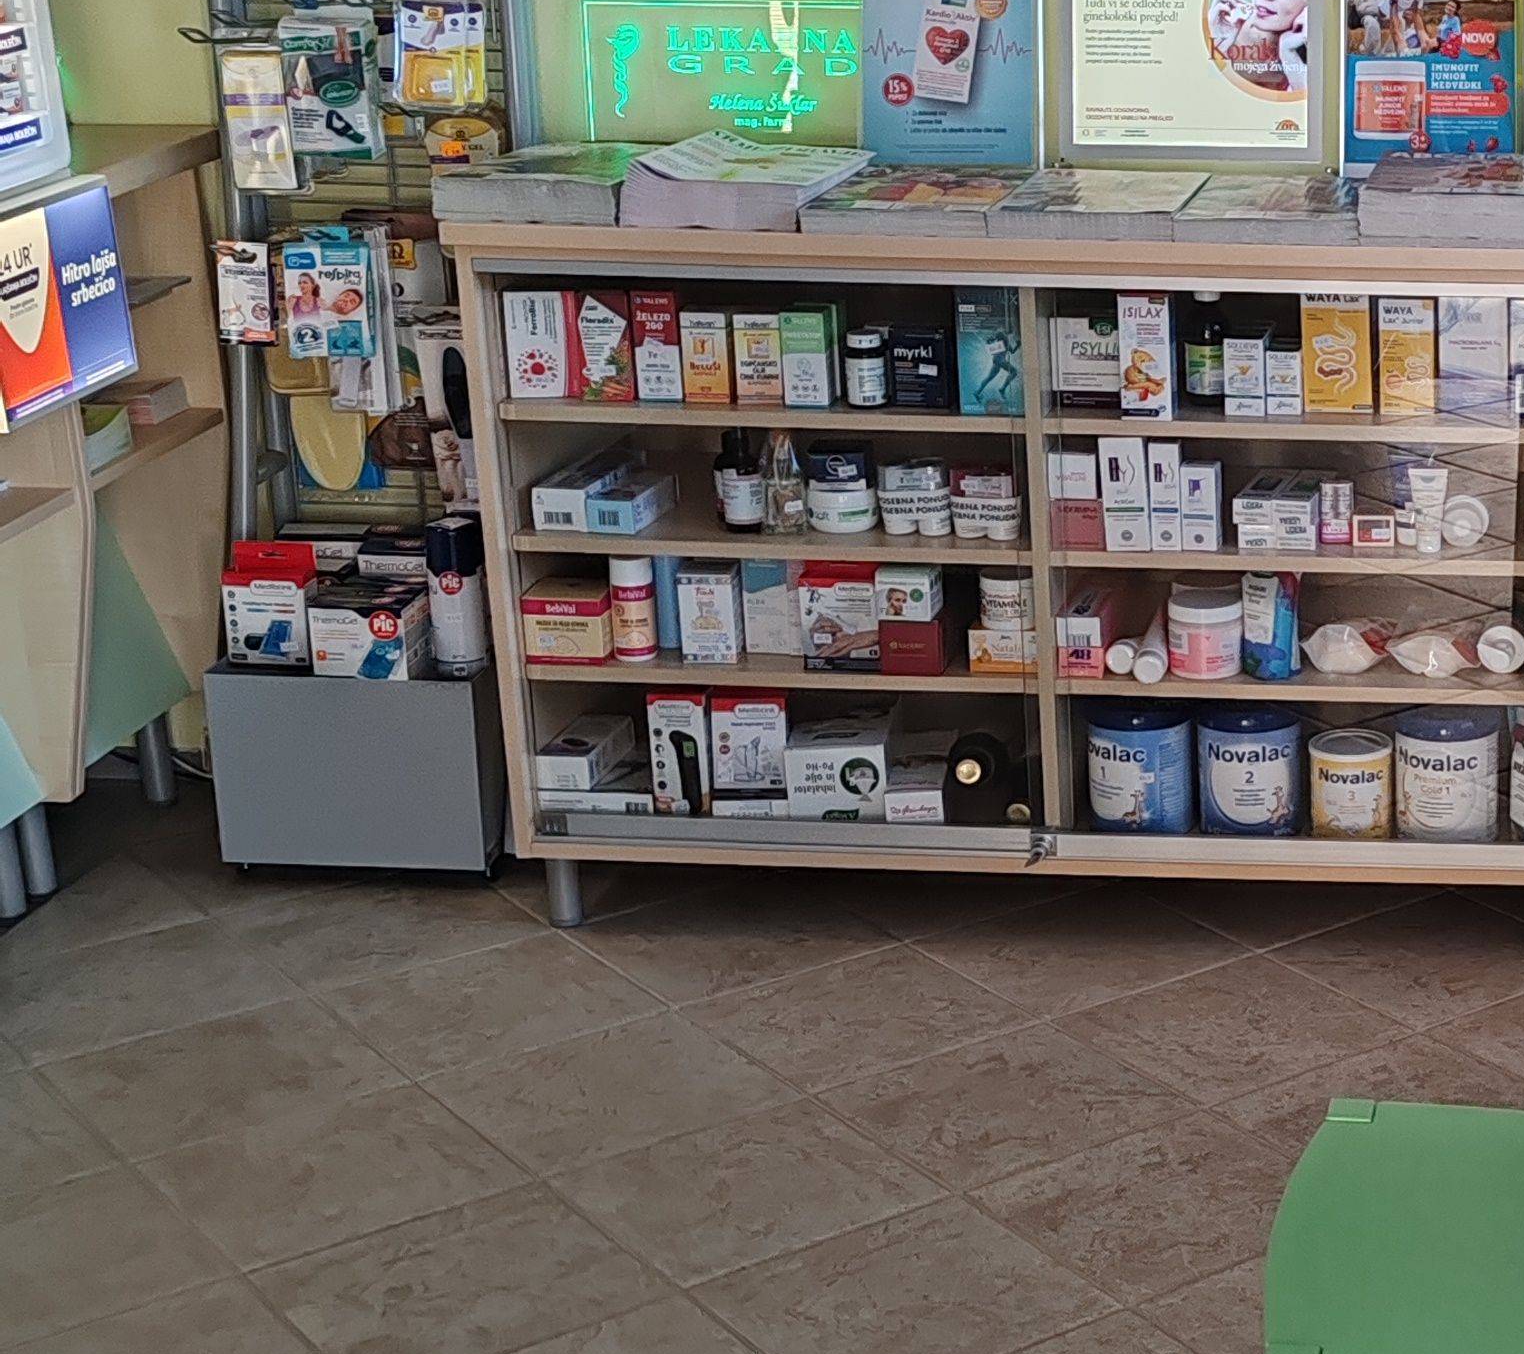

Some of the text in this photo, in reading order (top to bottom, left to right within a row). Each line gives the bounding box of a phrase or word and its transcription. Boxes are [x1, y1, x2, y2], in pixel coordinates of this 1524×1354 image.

[1174, 1, 1185, 9] za
[1083, 10, 1179, 24] ginekološki pregled!
[666, 26, 857, 54] LEKANA
[1462, 32, 1496, 44] NOVO
[667, 54, 858, 77] GRAD
[1431, 63, 1479, 72] IMUNOFIT
[1431, 72, 1466, 81] JUNIOR
[1431, 81, 1482, 90] MEDVEDKI
[14, 246, 32, 269] UR
[61, 248, 117, 285] Hitro lajša
[318, 268, 361, 282] respira
[71, 274, 116, 307] srbečico
[1305, 293, 1341, 303] WAYA
[635, 310, 671, 322] ŽELEZO
[1122, 307, 1163, 320] ISILAX
[1382, 305, 1413, 316] WAYA
[581, 316, 615, 325] Floradix
[893, 345, 933, 360] myrkl
[362, 559, 424, 573] ThermoGel
[440, 574, 460, 589] PiC
[311, 614, 358, 626] ThermoGel
[372, 614, 396, 634] PiC
[1208, 741, 1291, 763] Novalac
[1398, 746, 1479, 772] Novalac
[805, 761, 834, 771] Po-Ho
[804, 772, 836, 783] in olje
[1244, 771, 1254, 784] 2
[1318, 767, 1384, 784] Novalac
[1413, 773, 1457, 785] Premium
[1347, 790, 1357, 801] 3
